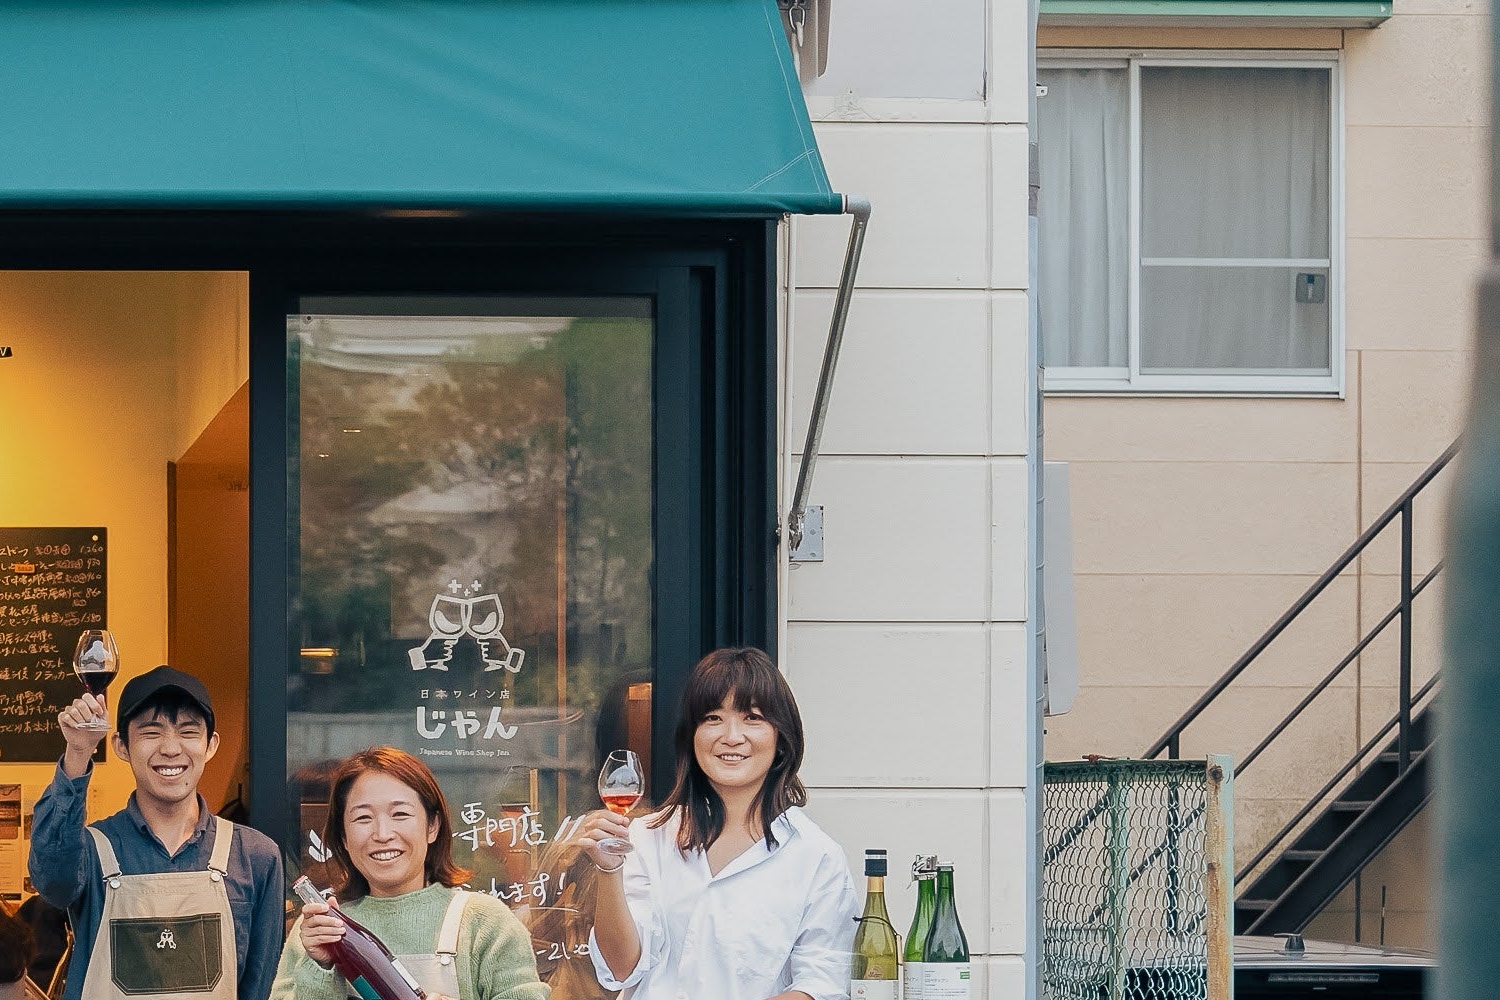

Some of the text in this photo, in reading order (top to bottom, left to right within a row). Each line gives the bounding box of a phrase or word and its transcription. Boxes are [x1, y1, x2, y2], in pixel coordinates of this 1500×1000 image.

[420, 689, 510, 699] 日本ワイン店
[416, 706, 519, 739] じゃん
[419, 748, 452, 756] Japanese
[476, 749, 495, 757] Shop
